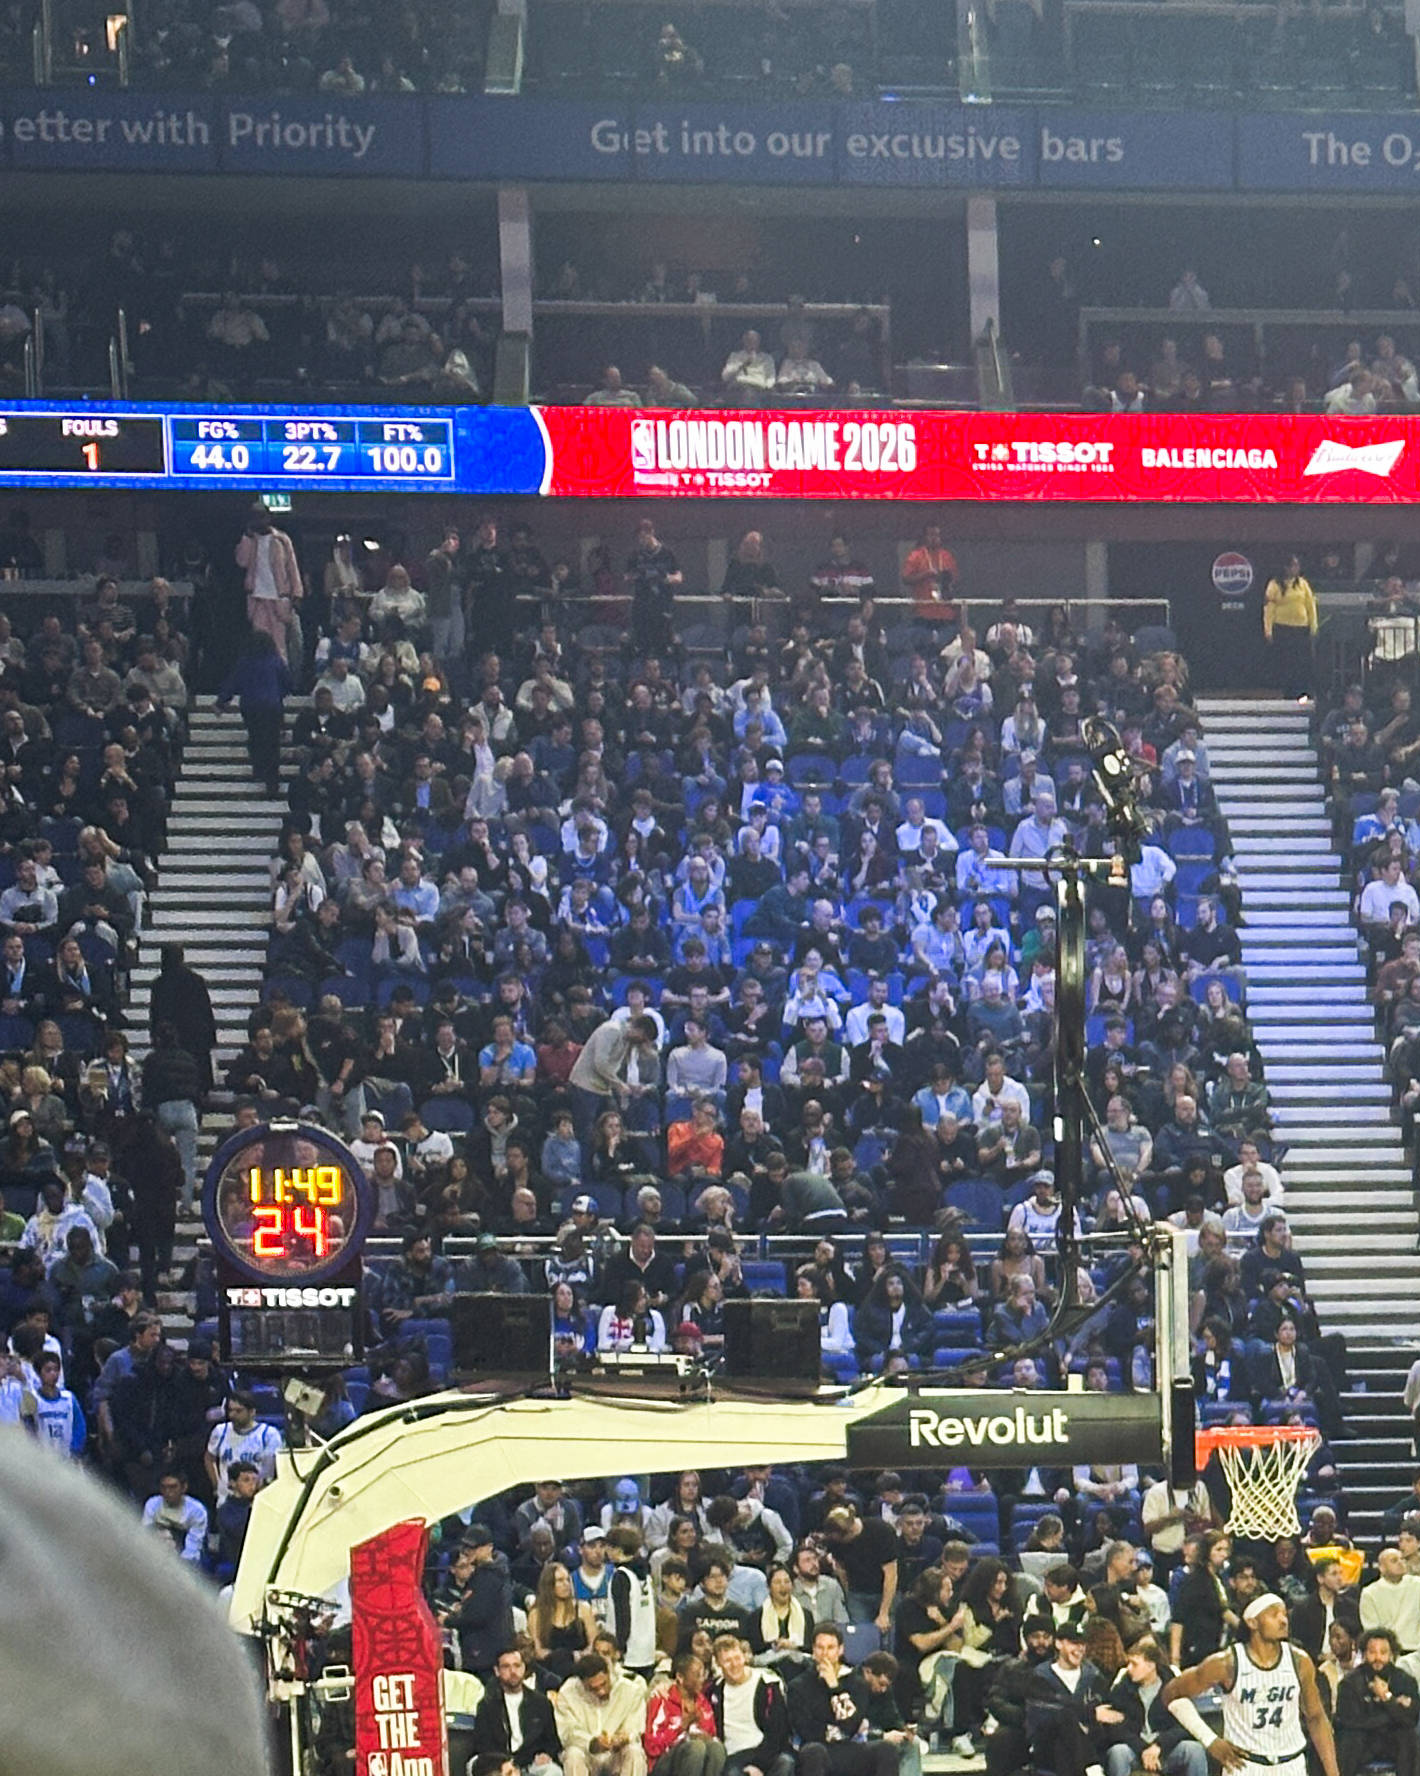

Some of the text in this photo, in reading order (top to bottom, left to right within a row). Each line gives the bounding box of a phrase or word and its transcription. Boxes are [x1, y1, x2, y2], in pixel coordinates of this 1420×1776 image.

[0, 110, 376, 157] etter with Priority
[590, 120, 1124, 162] Get into our exclusive bars
[1302, 132, 1372, 166] The
[61, 419, 119, 437] FOULS
[198, 421, 240, 439] FG%
[284, 422, 338, 440] 3PT%
[383, 423, 424, 442] FT%
[81, 442, 99, 470] 1
[190, 444, 249, 471] 44.0
[282, 445, 342, 471] 22.7
[367, 446, 442, 473] 100.0
[656, 420, 917, 472] LONDON GAME 2026
[1011, 441, 1114, 464] TISSOT
[1141, 448, 1278, 469] BALENCIAGA
[705, 472, 773, 487] TISSOT
[1214, 566, 1251, 581] PEPSI
[250, 1167, 342, 1205] 11:49
[251, 1205, 327, 1258] 24
[261, 1287, 356, 1308] TISSOT
[909, 1406, 1069, 1447] Revolut
[371, 1673, 417, 1712] GET
[374, 1711, 420, 1750] THE
[1252, 1706, 1283, 1730] 34
